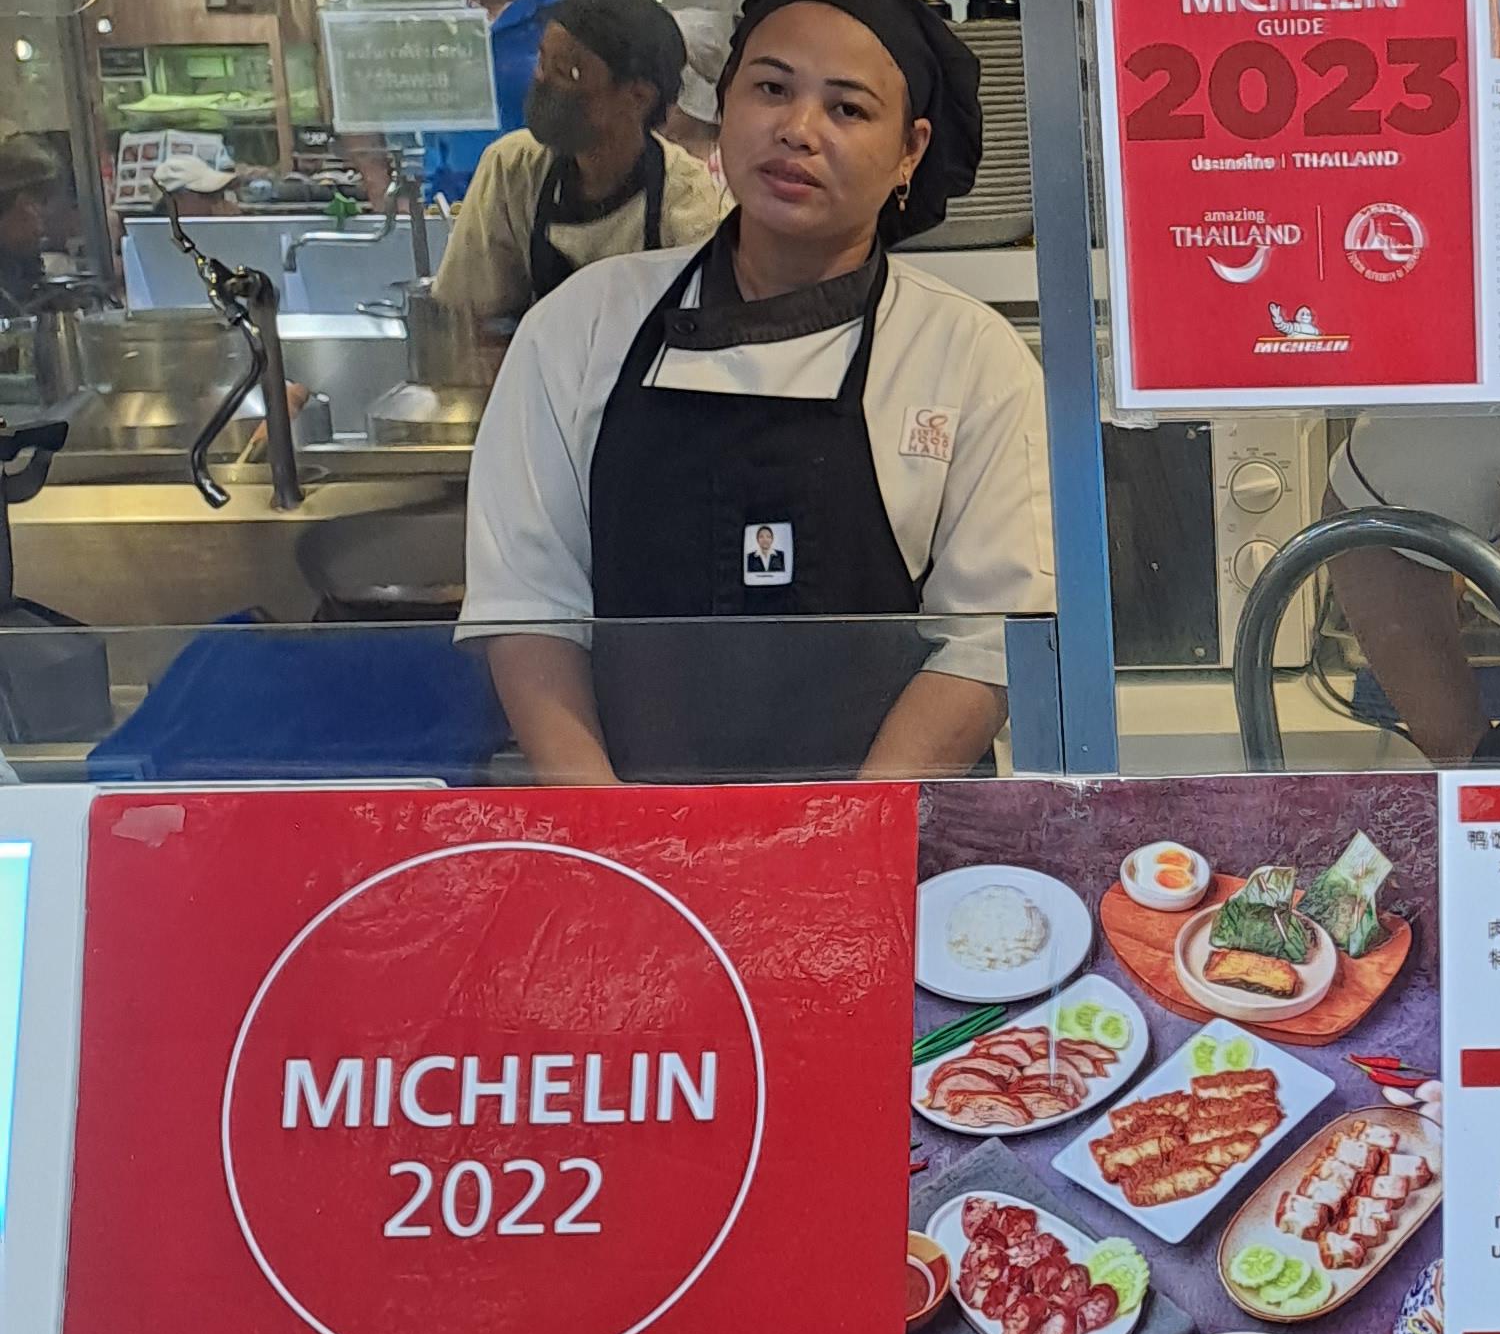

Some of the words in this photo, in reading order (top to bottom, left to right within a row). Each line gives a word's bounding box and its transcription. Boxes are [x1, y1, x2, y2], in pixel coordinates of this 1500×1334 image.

[1257, 18, 1326, 36] GUIDE
[1124, 37, 1462, 141] 2023
[1292, 150, 1399, 168] THAILAND
[1204, 208, 1266, 223] amazing
[1170, 224, 1302, 247] THAILAND
[1253, 339, 1349, 354] MICHELIN
[282, 1052, 716, 1128] MICHELIN
[384, 1159, 601, 1237] 2022
